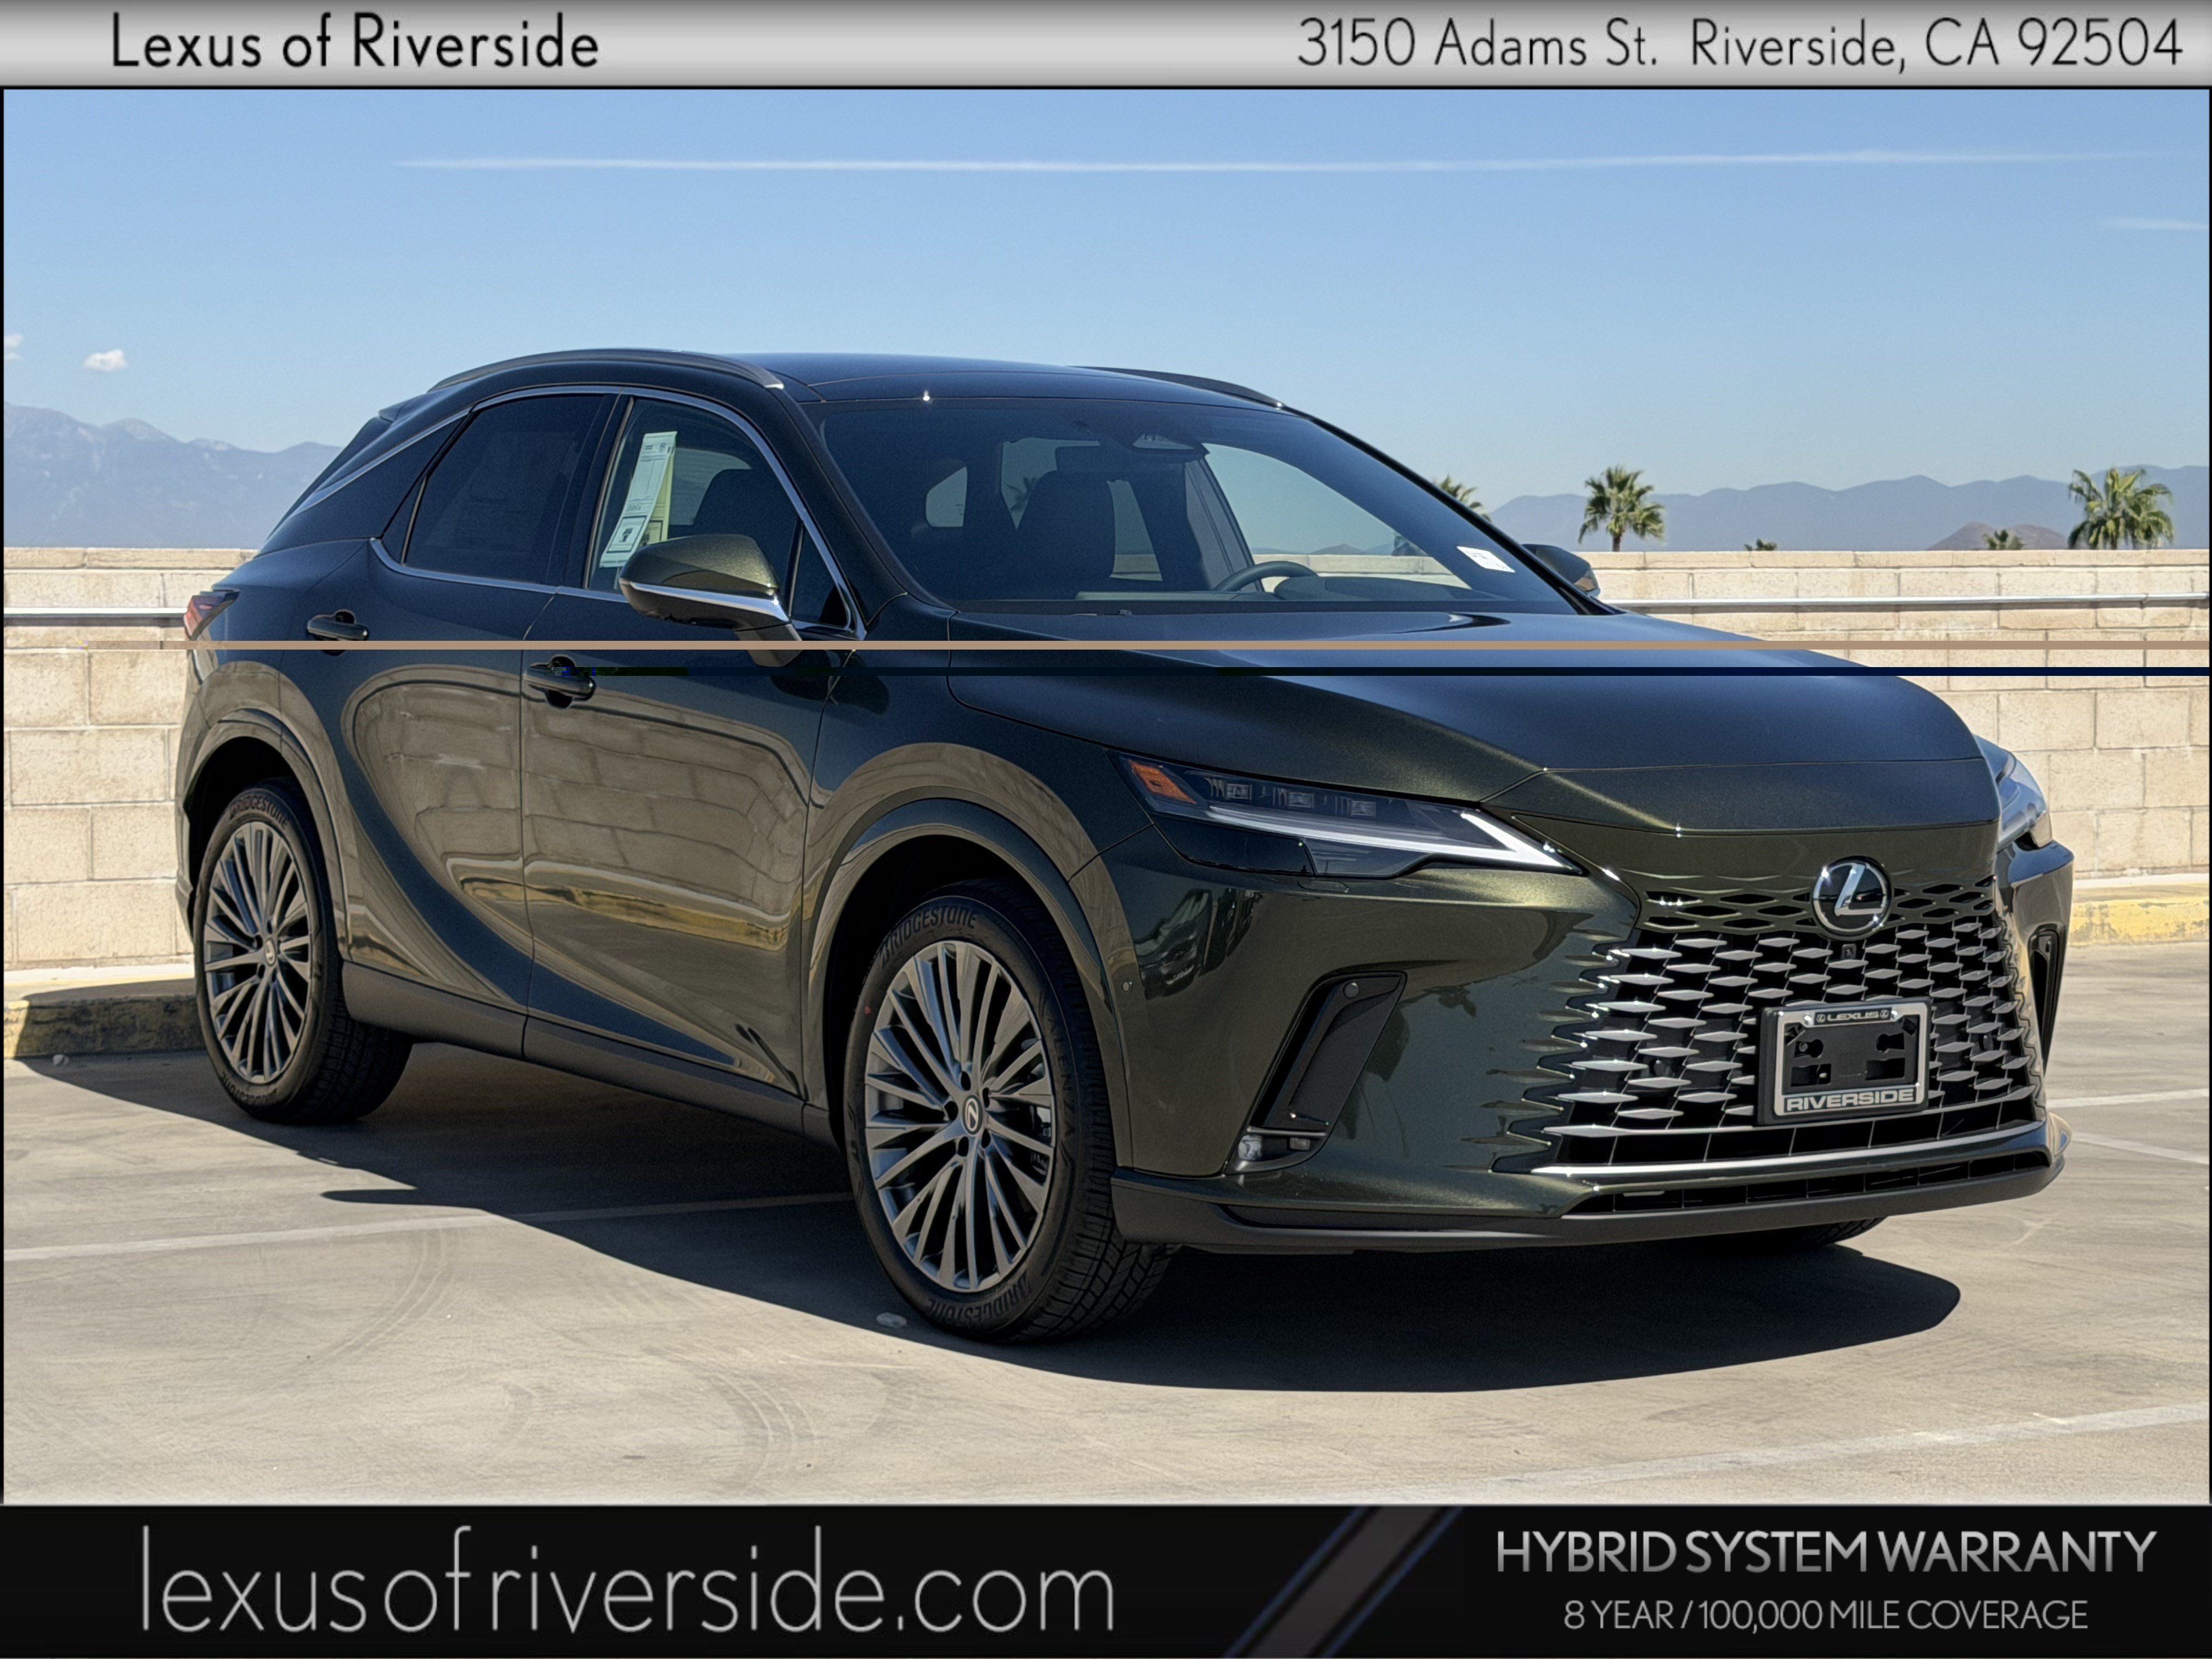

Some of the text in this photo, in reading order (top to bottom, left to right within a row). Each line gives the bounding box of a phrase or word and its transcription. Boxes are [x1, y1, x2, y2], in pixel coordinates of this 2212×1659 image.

[881, 905, 978, 967] BRIDGESTONE
[1826, 1011, 1880, 1022] LEXUS
[1786, 1088, 1915, 1111] RIVERSIDE
